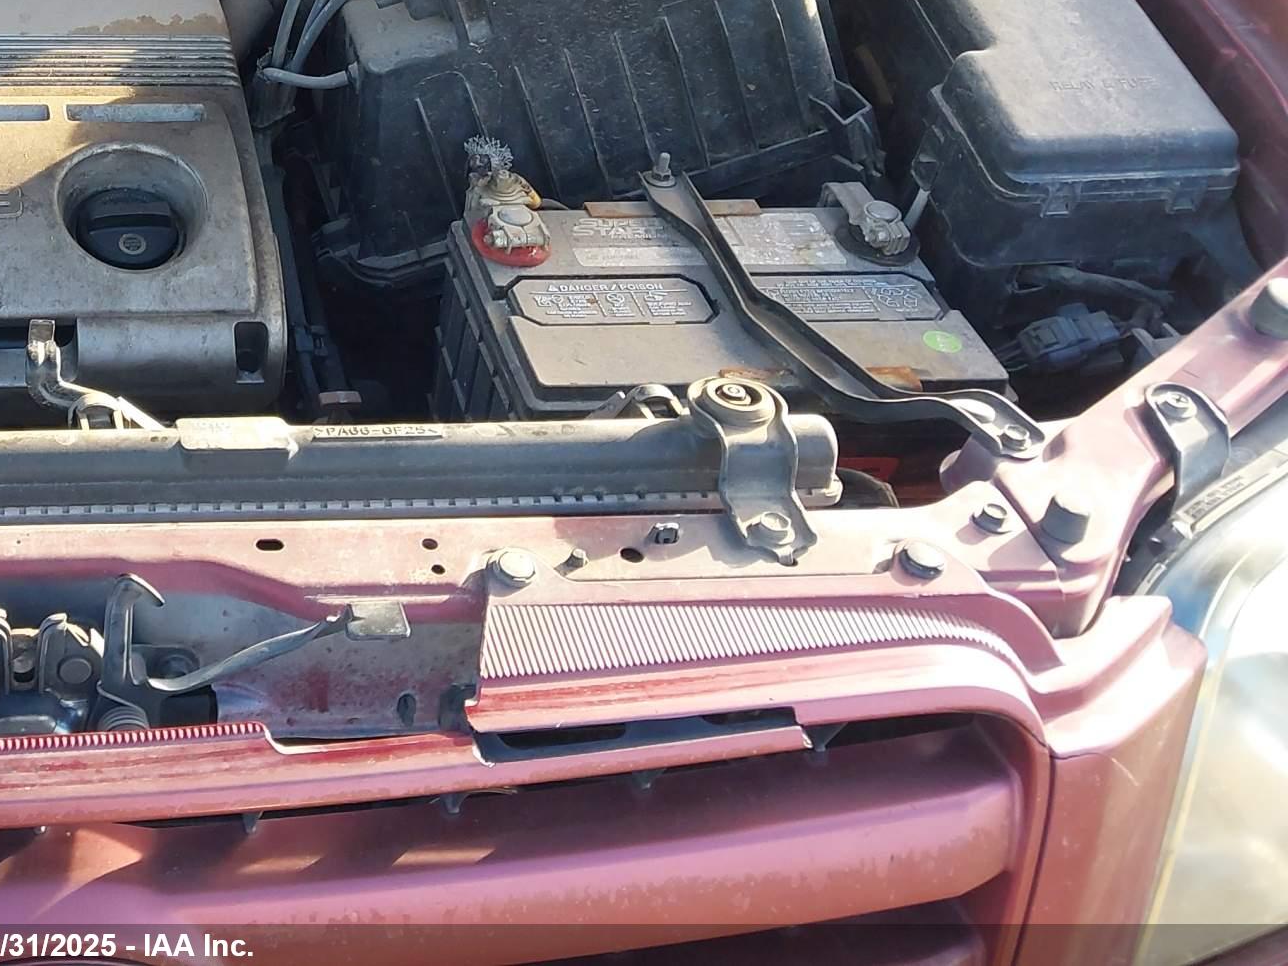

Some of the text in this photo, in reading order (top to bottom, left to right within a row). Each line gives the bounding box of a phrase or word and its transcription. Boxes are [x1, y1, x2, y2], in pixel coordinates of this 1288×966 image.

[572, 226, 664, 237] START
[560, 284, 609, 292] DANGER
[620, 283, 664, 291] POISON
